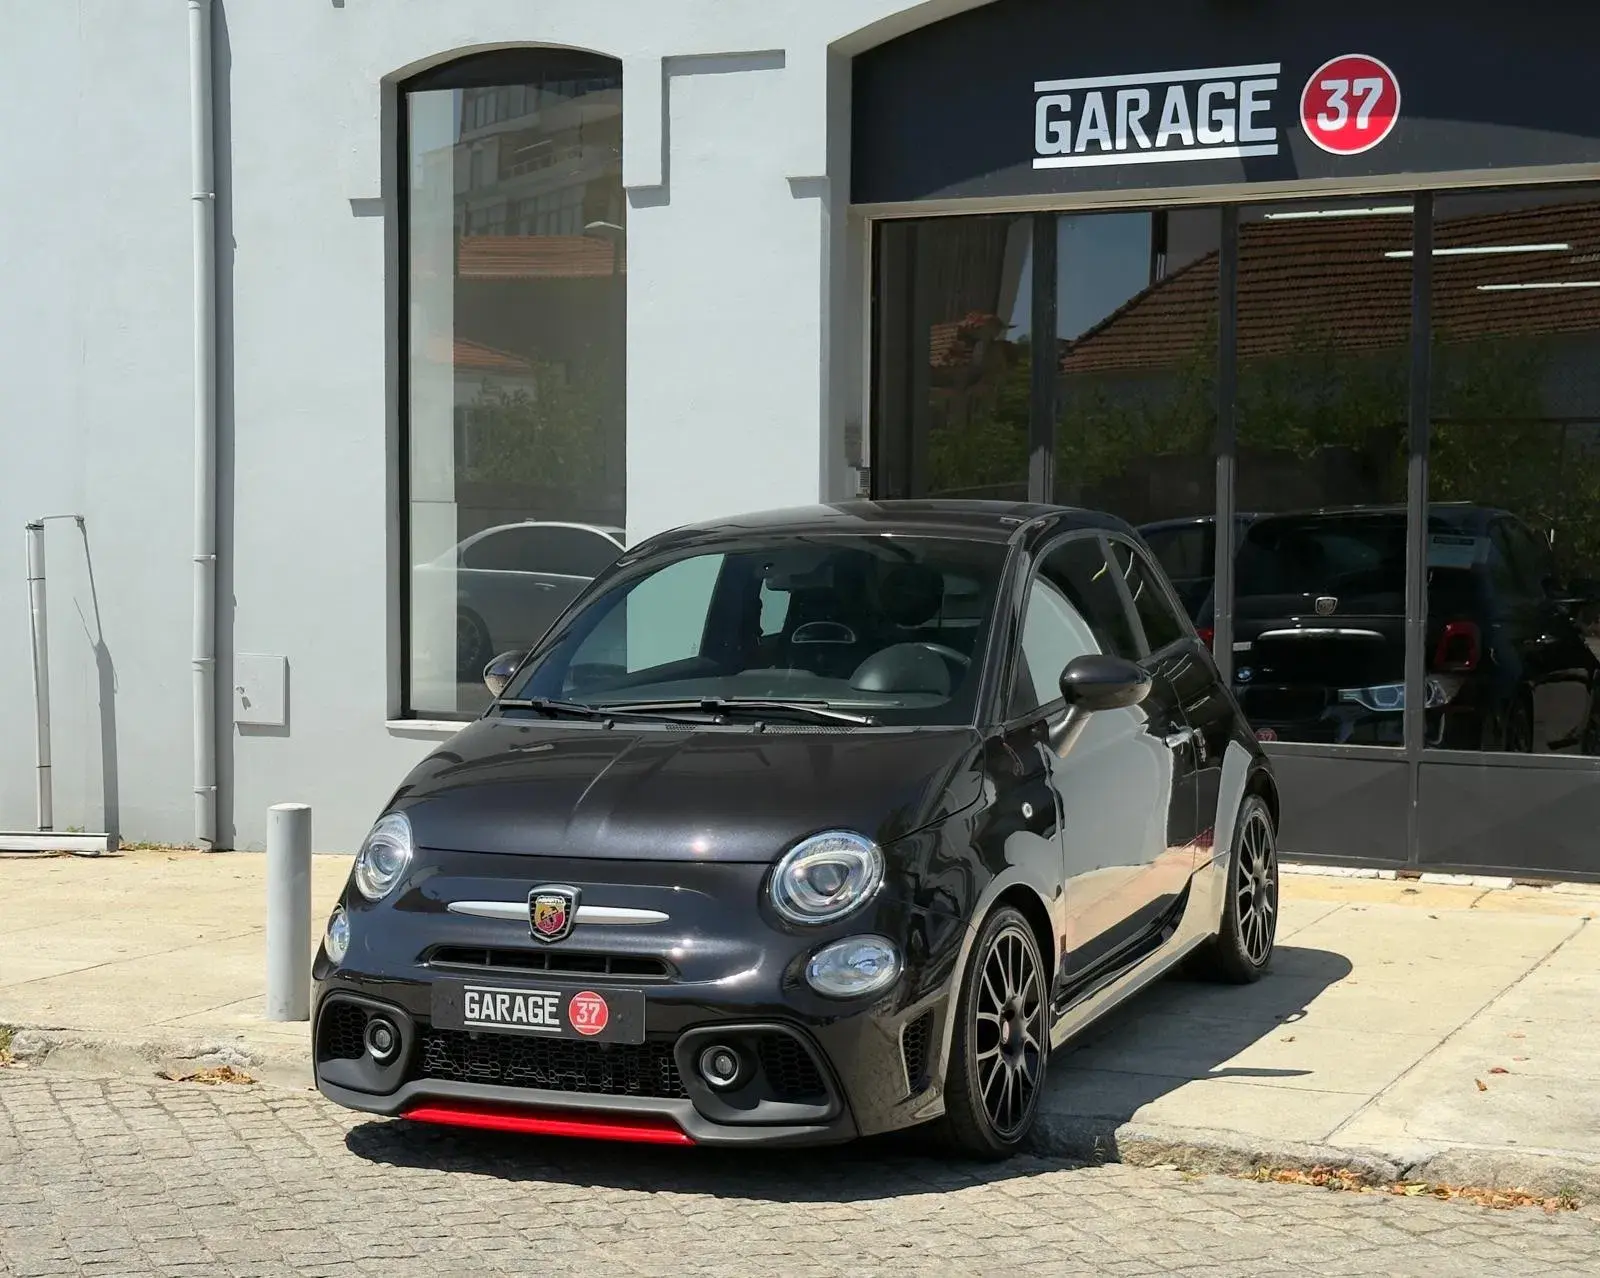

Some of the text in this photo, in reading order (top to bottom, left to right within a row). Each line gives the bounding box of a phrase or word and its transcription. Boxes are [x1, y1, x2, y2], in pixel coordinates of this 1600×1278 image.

[1035, 77, 1383, 155] GARAGE 37
[465, 992, 600, 1024] GARAGE 37
